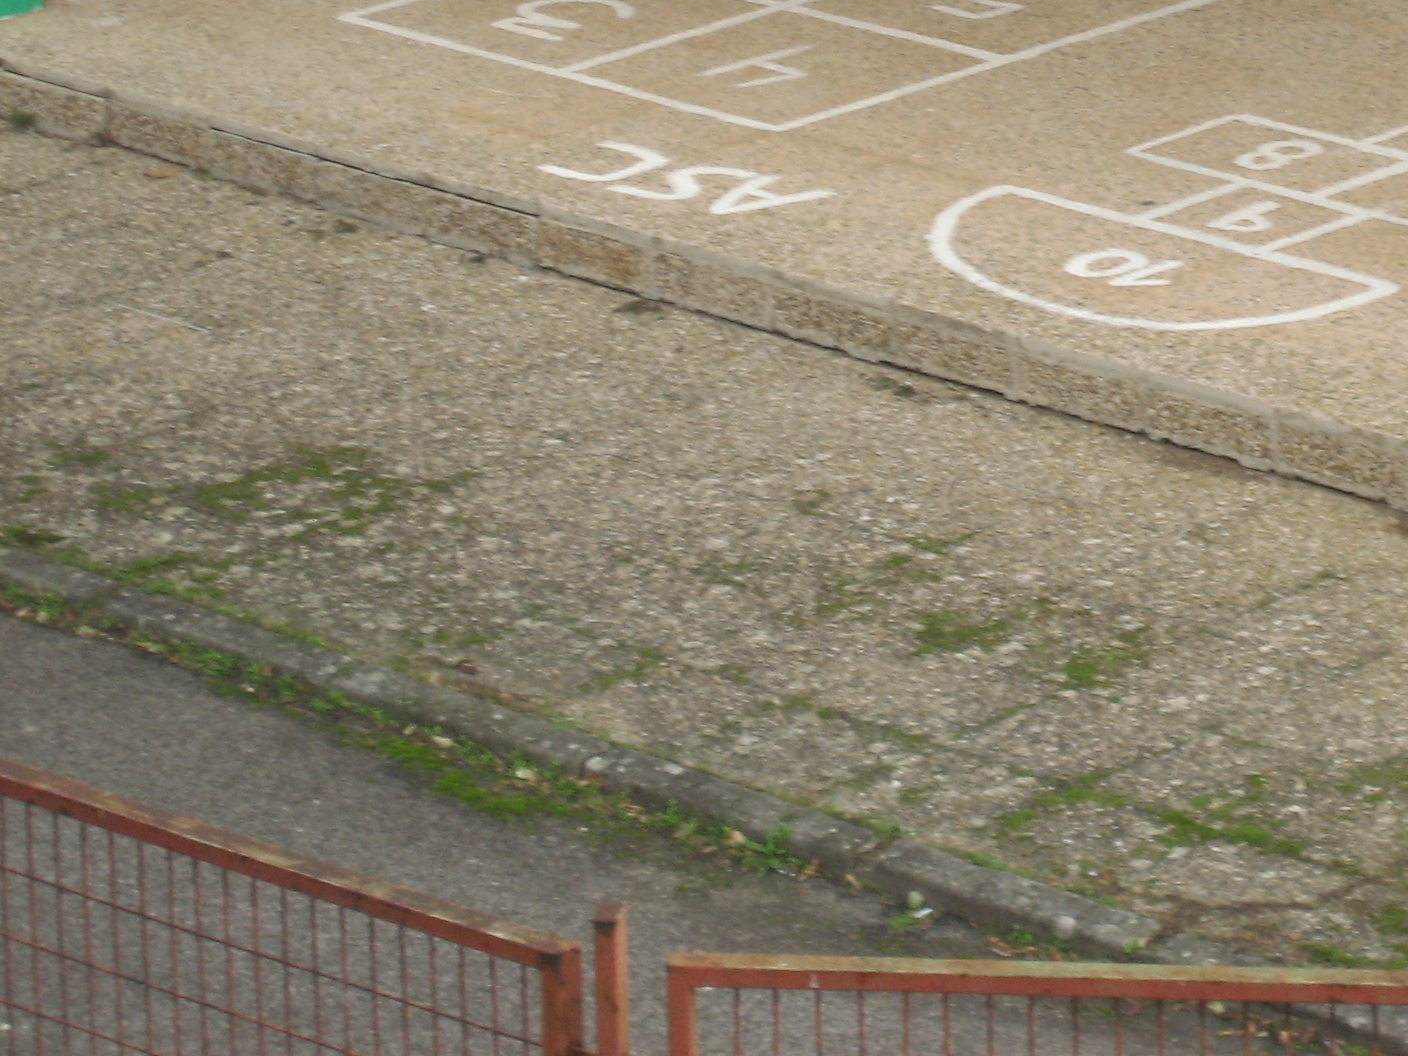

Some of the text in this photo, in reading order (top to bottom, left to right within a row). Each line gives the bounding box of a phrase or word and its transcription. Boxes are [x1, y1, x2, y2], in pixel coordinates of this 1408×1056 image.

[697, 45, 814, 88] 4
[1234, 137, 1323, 171] 8
[1063, 247, 1184, 291] 10
